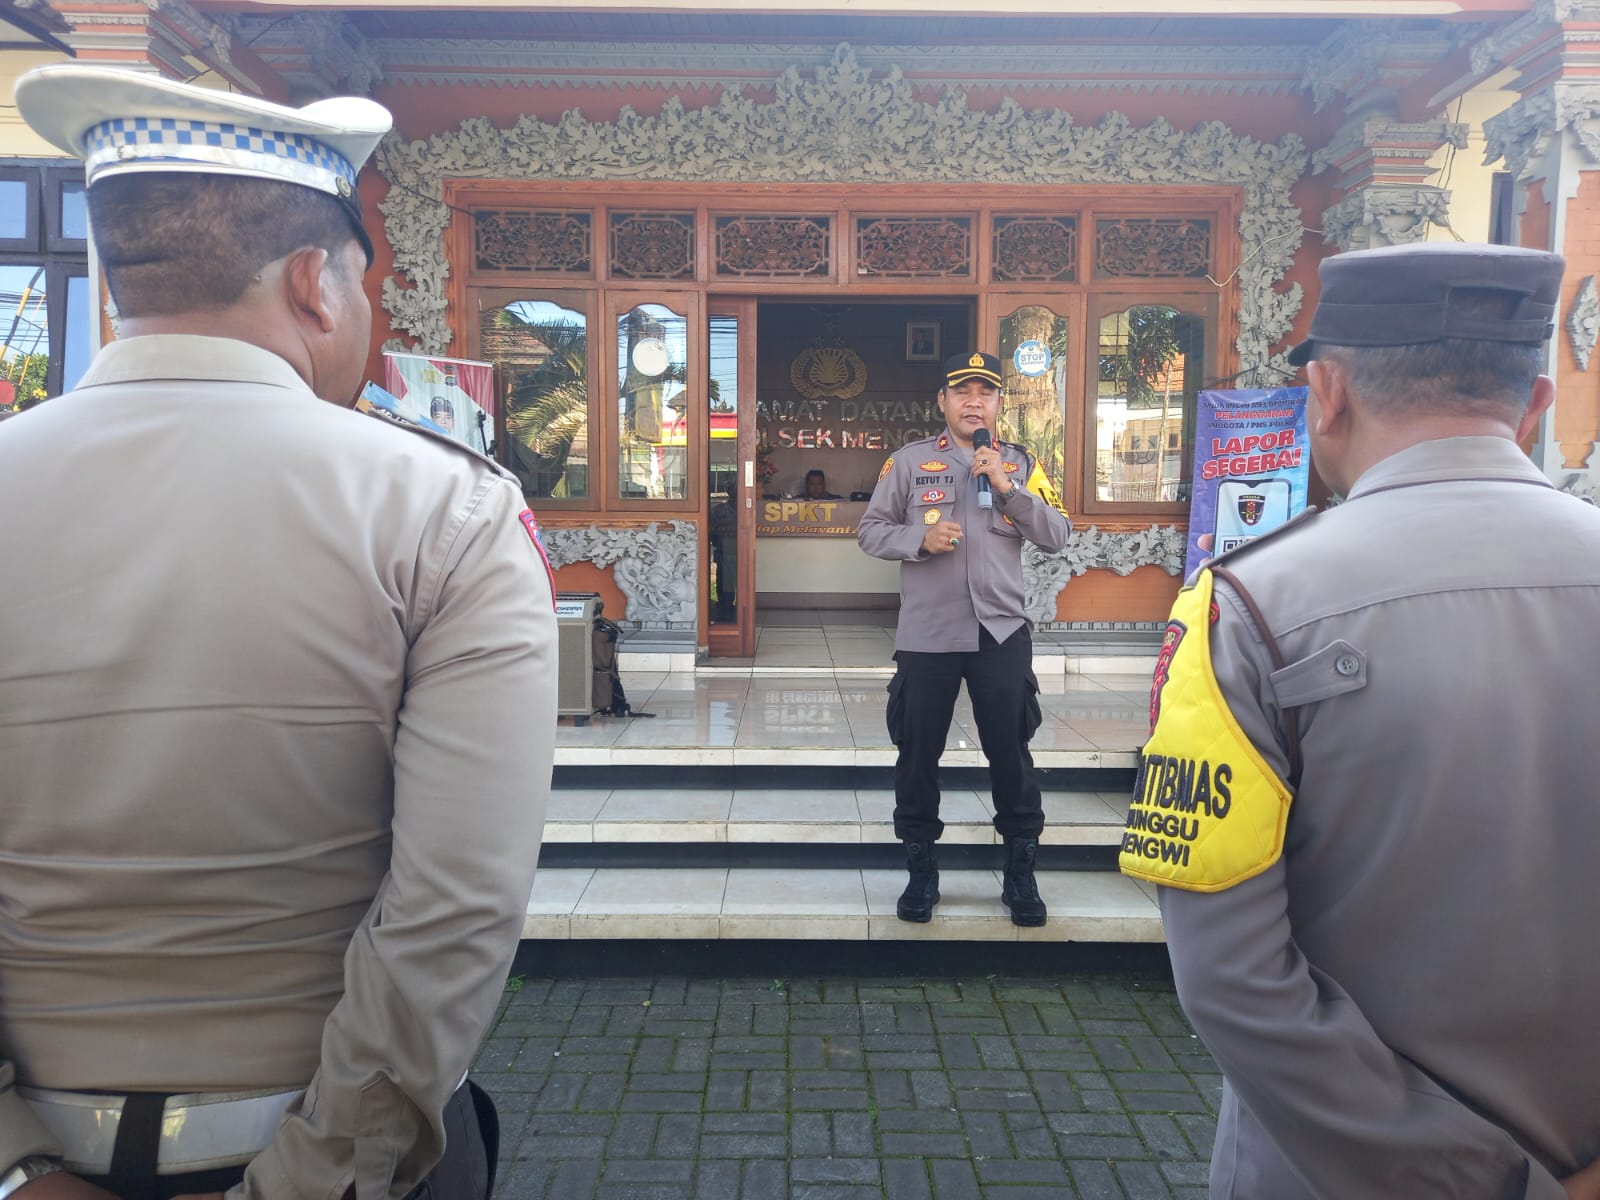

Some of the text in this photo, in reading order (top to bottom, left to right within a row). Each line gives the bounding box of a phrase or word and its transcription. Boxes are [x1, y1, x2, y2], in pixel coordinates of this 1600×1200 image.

[1021, 353, 1045, 362] STOP
[1215, 408, 1295, 420] PELANGGARAN
[1212, 429, 1296, 456] LAPOR
[1203, 449, 1302, 480] SEGERA!
[916, 476, 940, 486] KETUT
[764, 502, 837, 522] SPKT
